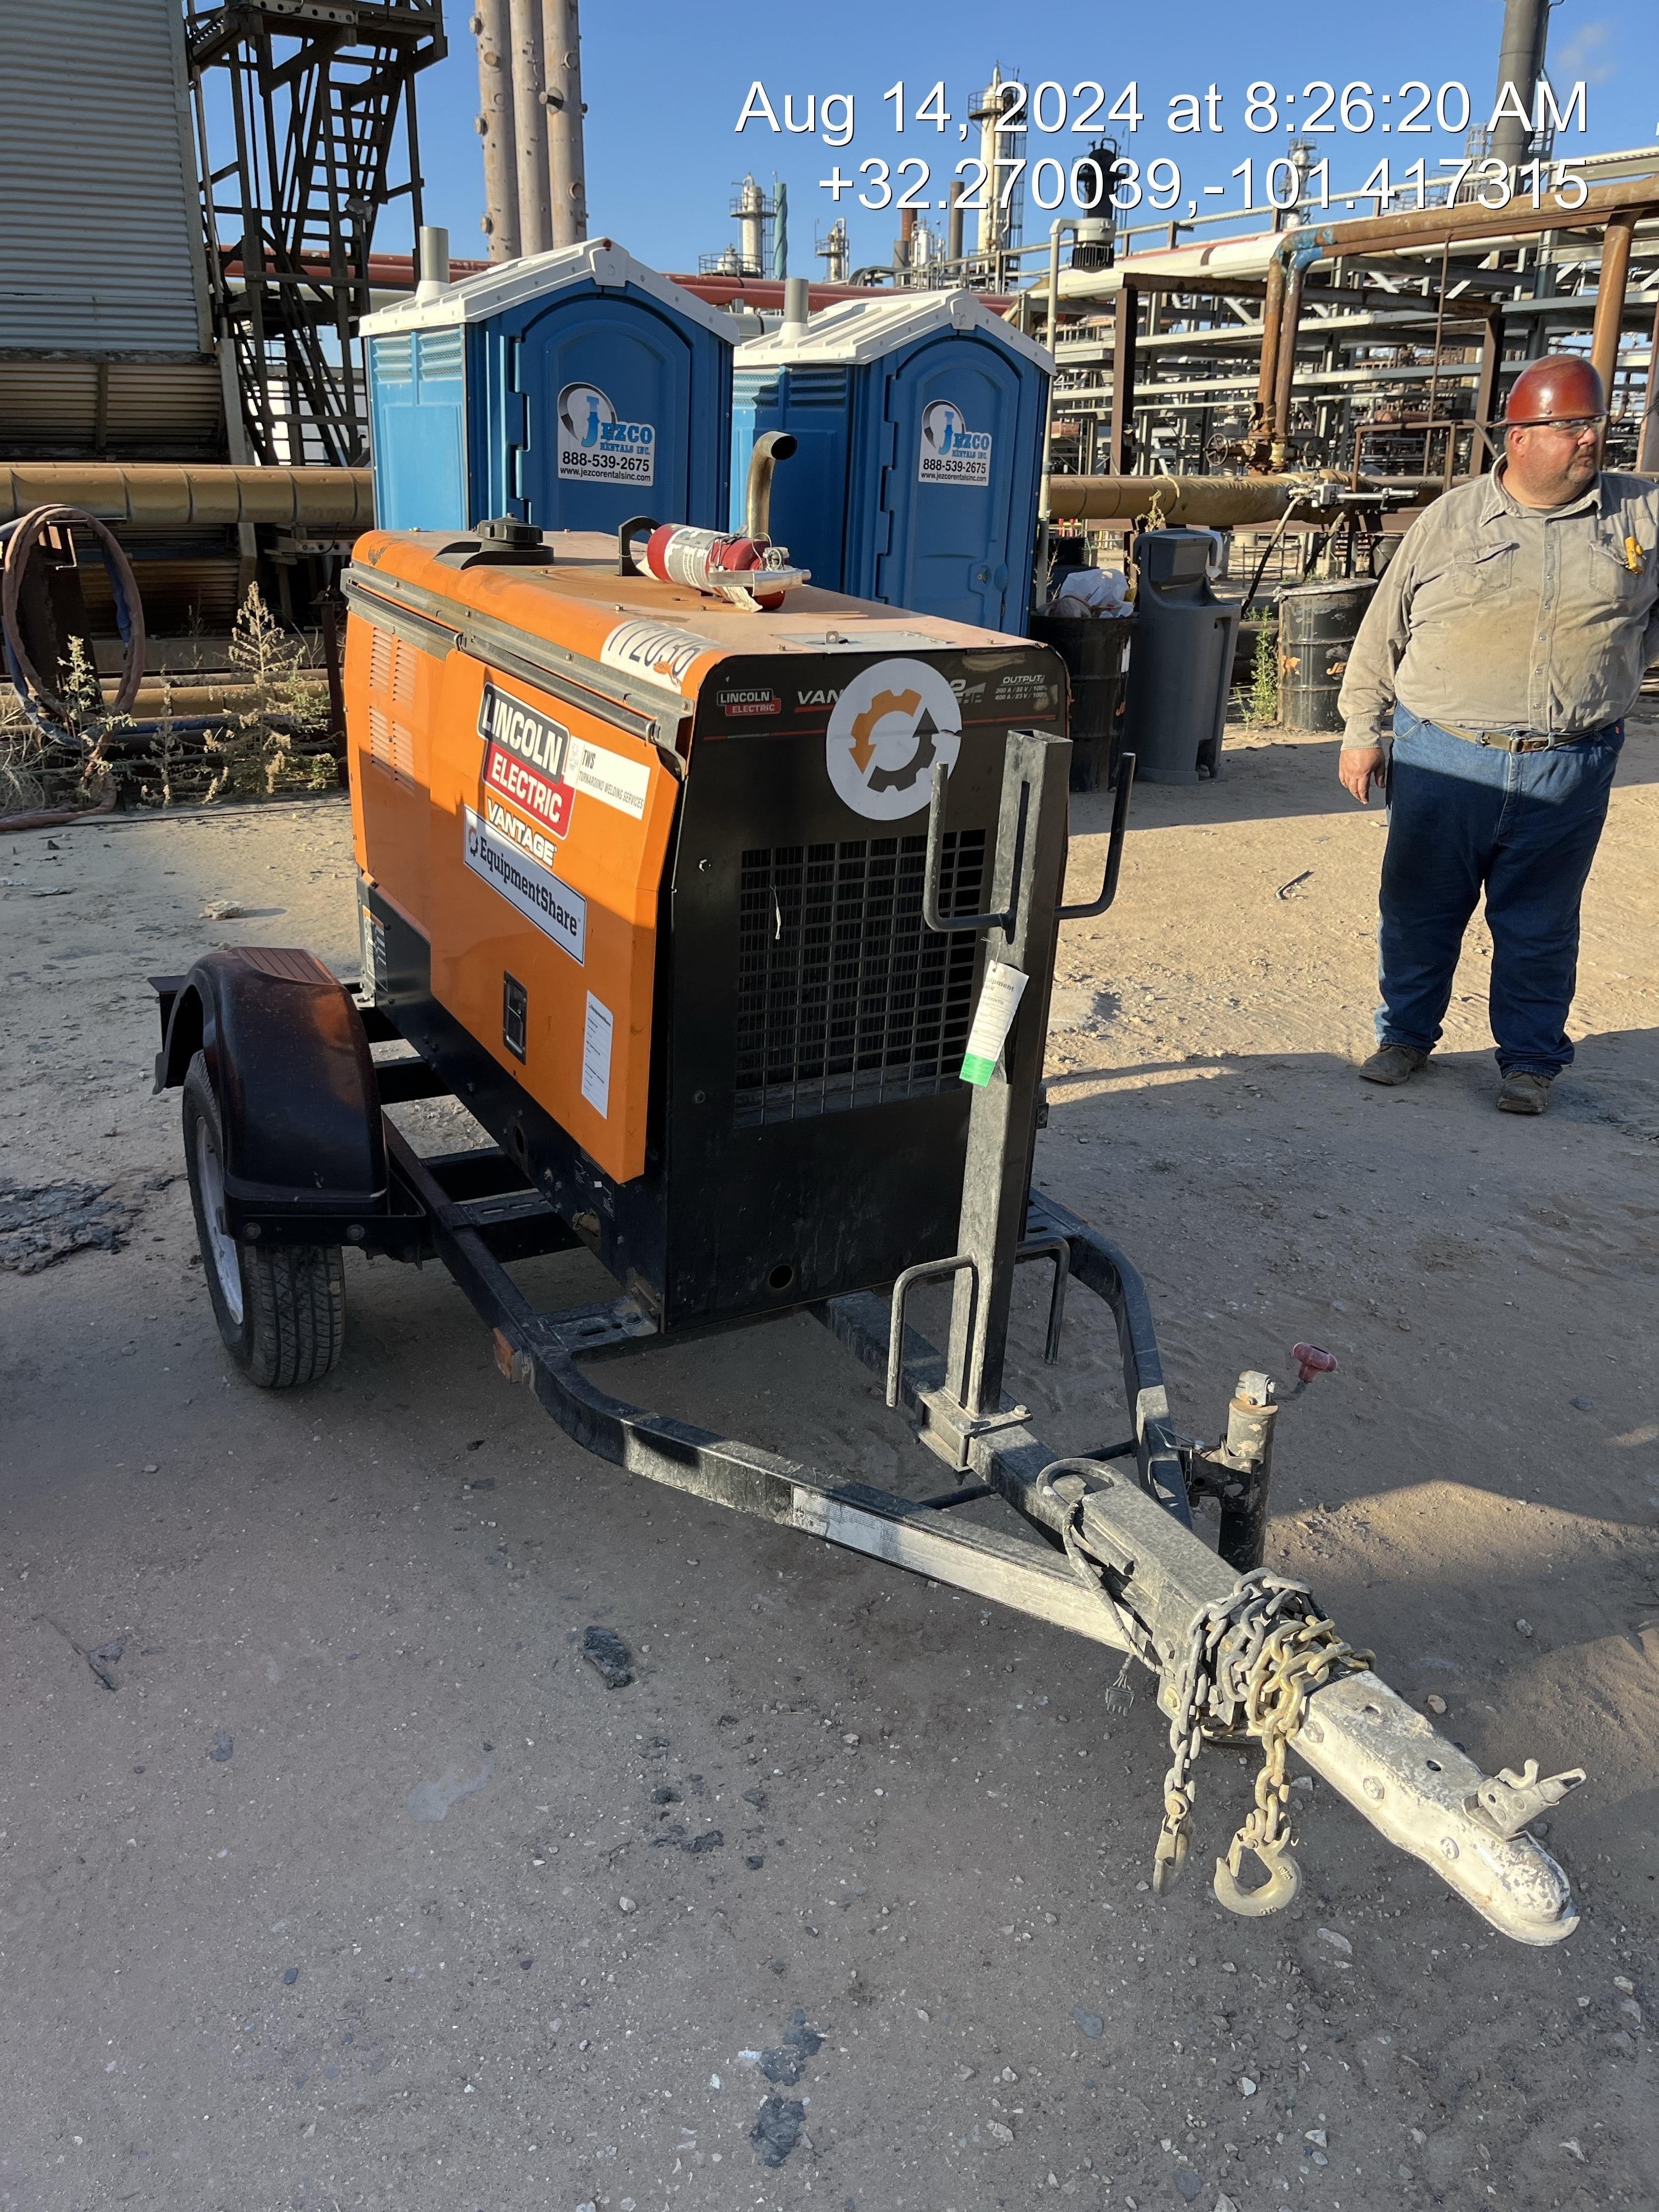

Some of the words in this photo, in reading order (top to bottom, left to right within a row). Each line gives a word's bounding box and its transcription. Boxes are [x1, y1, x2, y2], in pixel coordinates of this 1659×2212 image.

[581, 396, 652, 448] JEZCO
[938, 410, 990, 455] JEZCO
[562, 451, 650, 472] 888-539-2675
[923, 459, 986, 474] 888-539-2675
[560, 467, 651, 482] www.jezcorentalsinc.com
[921, 472, 987, 482] www.jezcorentalsinc.com
[1002, 674, 1042, 684] OUTPUT
[720, 691, 770, 704] LINCOLN
[731, 704, 775, 714] ELECTRIC
[482, 692, 563, 776] LINCOLN
[582, 749, 596, 769] TWS
[490, 752, 563, 823] ELECTRIC
[579, 771, 604, 791] TURNAROUND
[605, 782, 623, 800] WELDING
[623, 792, 644, 809] SERVICES
[487, 798, 554, 867] VANTAGE
[479, 836, 578, 937] EquipmentShare
